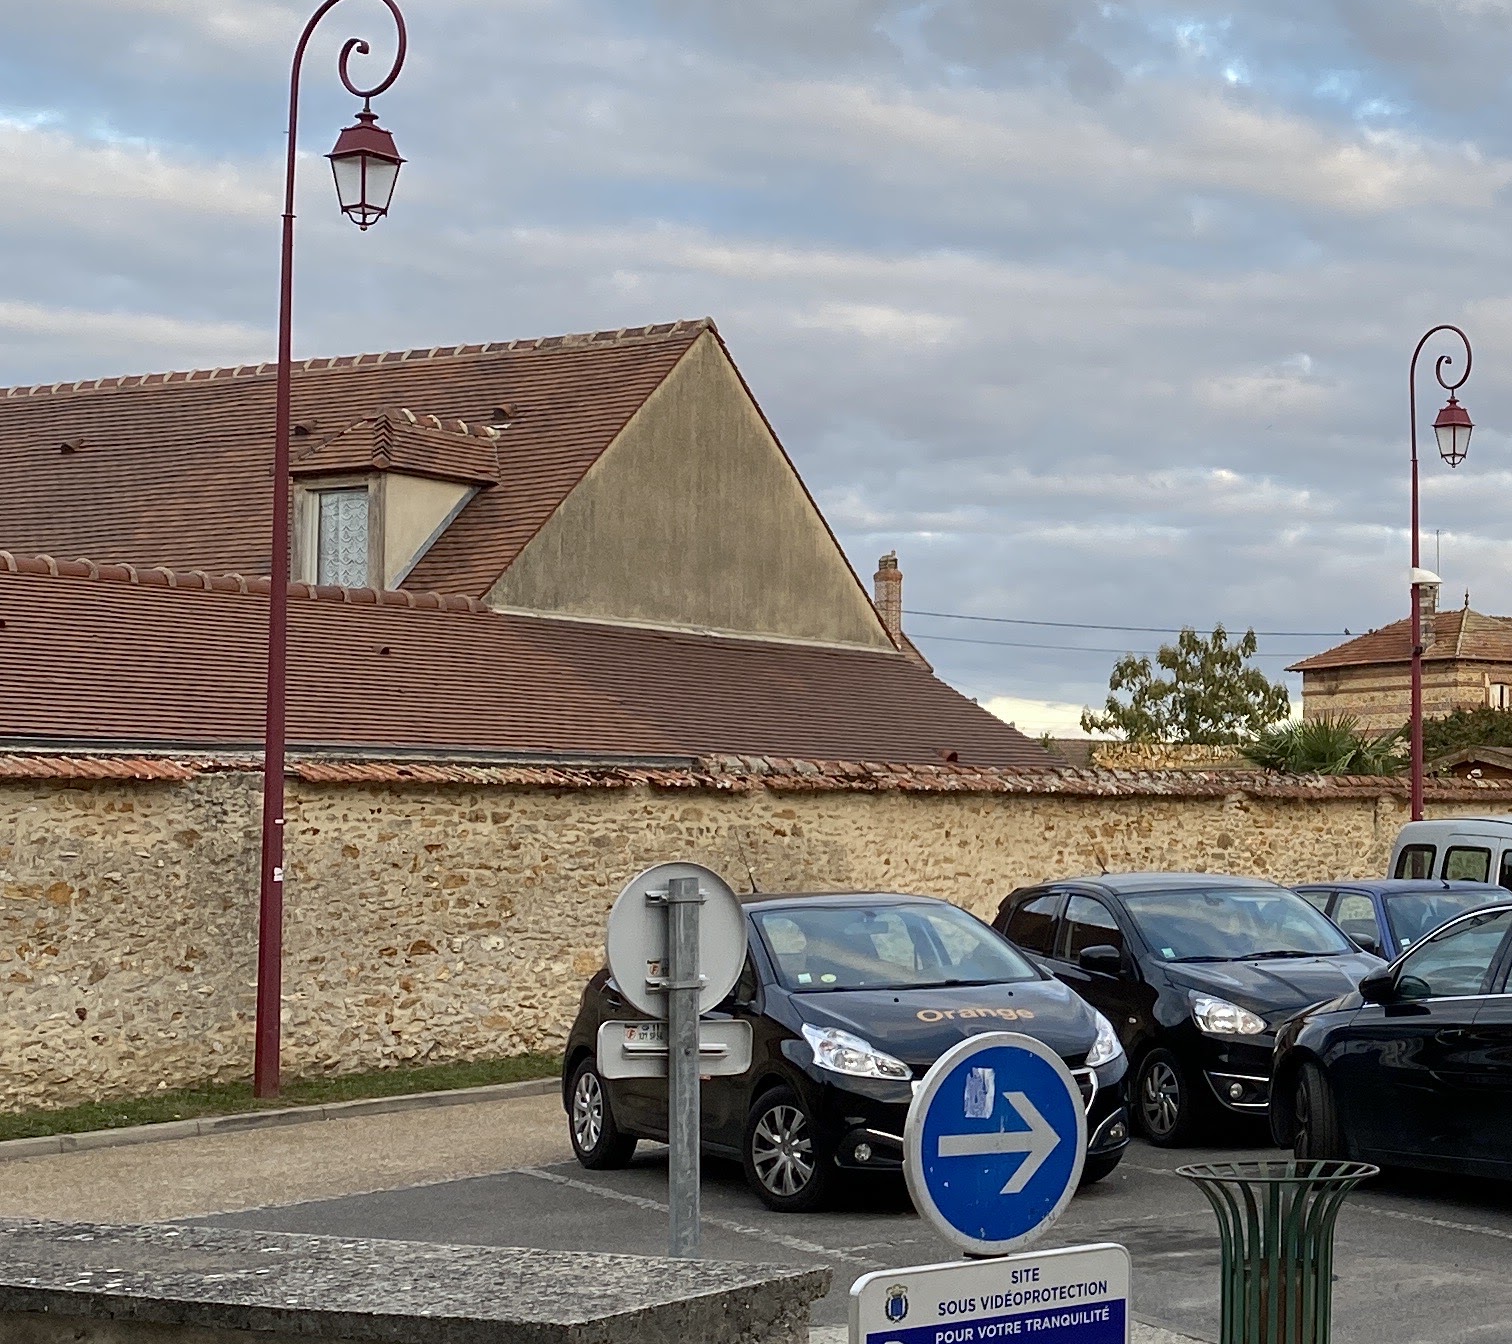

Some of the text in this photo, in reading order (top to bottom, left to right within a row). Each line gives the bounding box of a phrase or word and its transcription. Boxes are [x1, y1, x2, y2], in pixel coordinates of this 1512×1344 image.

[916, 1008, 1035, 1022] Orange
[1011, 1267, 1040, 1284] SITE
[938, 1280, 1108, 1316] SOUS VIDÉOPROTECTION
[935, 1306, 1110, 1344] POUR VOTRE TRANQUILITÉ
